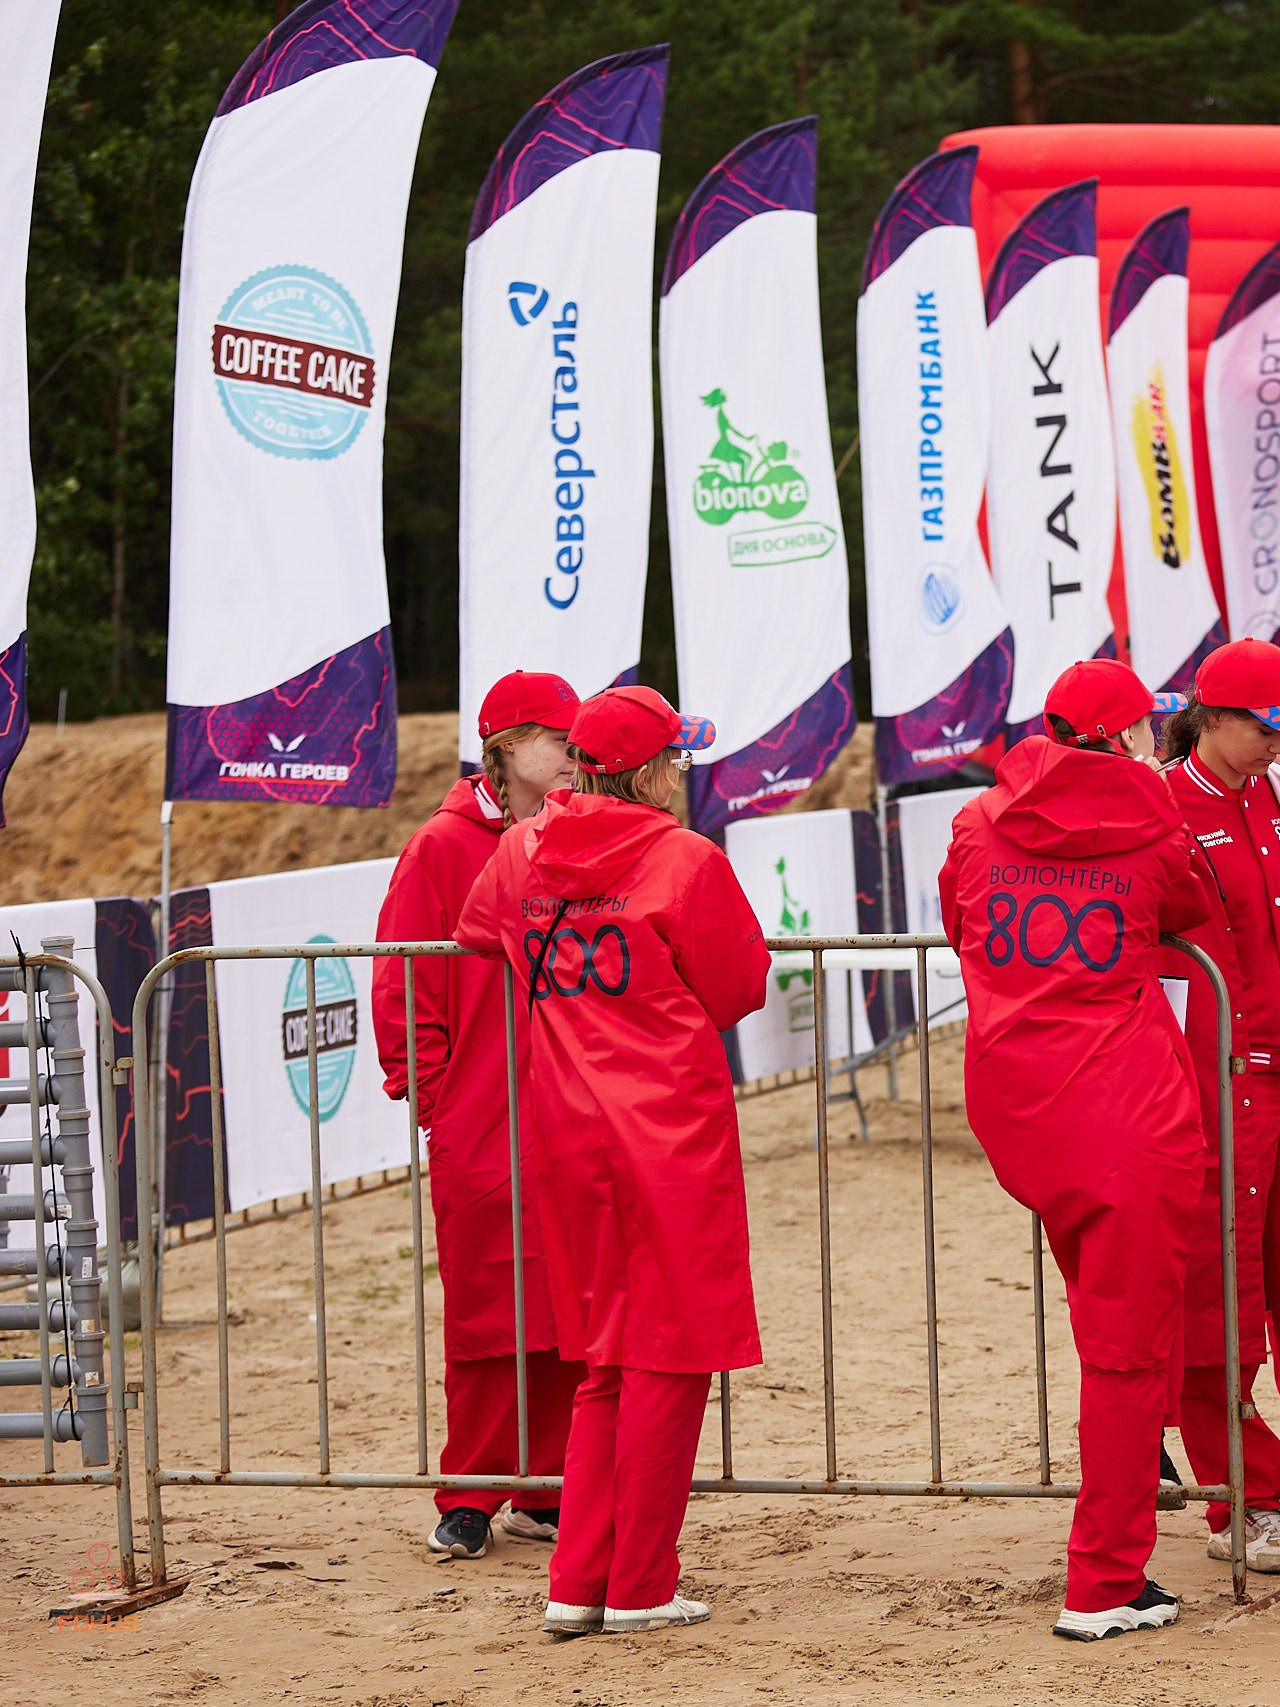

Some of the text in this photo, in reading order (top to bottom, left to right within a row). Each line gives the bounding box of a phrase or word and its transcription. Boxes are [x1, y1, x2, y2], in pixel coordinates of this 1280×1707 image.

[252, 286, 306, 312] MEANT
[312, 293, 331, 312] TO
[220, 334, 366, 399] COFFEE CAKE
[915, 289, 945, 541] ГАЗПРОМБАНК
[544, 300, 596, 610] Северсталь
[1030, 341, 1081, 621] TANK
[696, 478, 807, 512] bionova
[763, 533, 828, 553] ОСНОВА
[219, 762, 349, 781] ГОНКА ГЕРОЕВ
[989, 865, 1132, 896] ВОЛОНТЁРЫ
[985, 892, 1124, 972] 800
[524, 924, 630, 1001] 800
[285, 1012, 327, 1054] COFE
